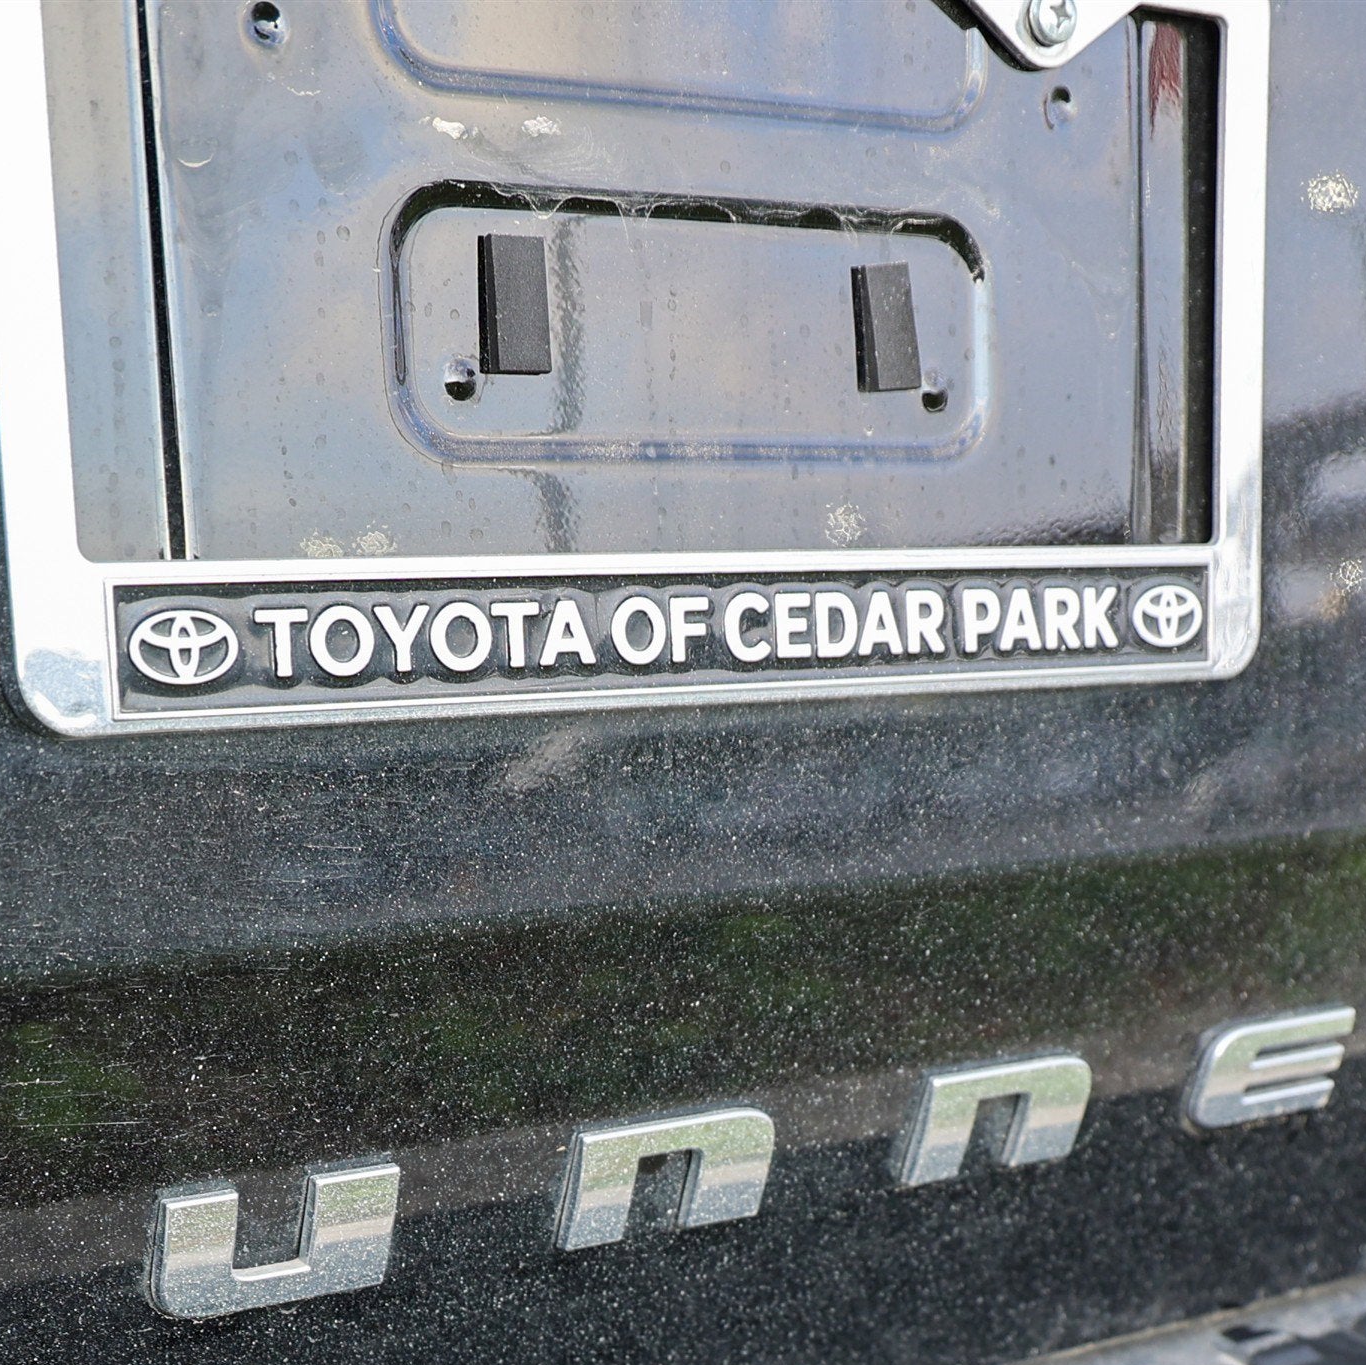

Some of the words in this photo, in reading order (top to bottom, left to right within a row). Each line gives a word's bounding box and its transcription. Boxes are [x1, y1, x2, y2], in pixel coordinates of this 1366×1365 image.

[253, 599, 597, 678] TOYOTA
[610, 596, 710, 666] OF
[723, 589, 946, 663] CEDAR
[961, 585, 1120, 654] PARK
